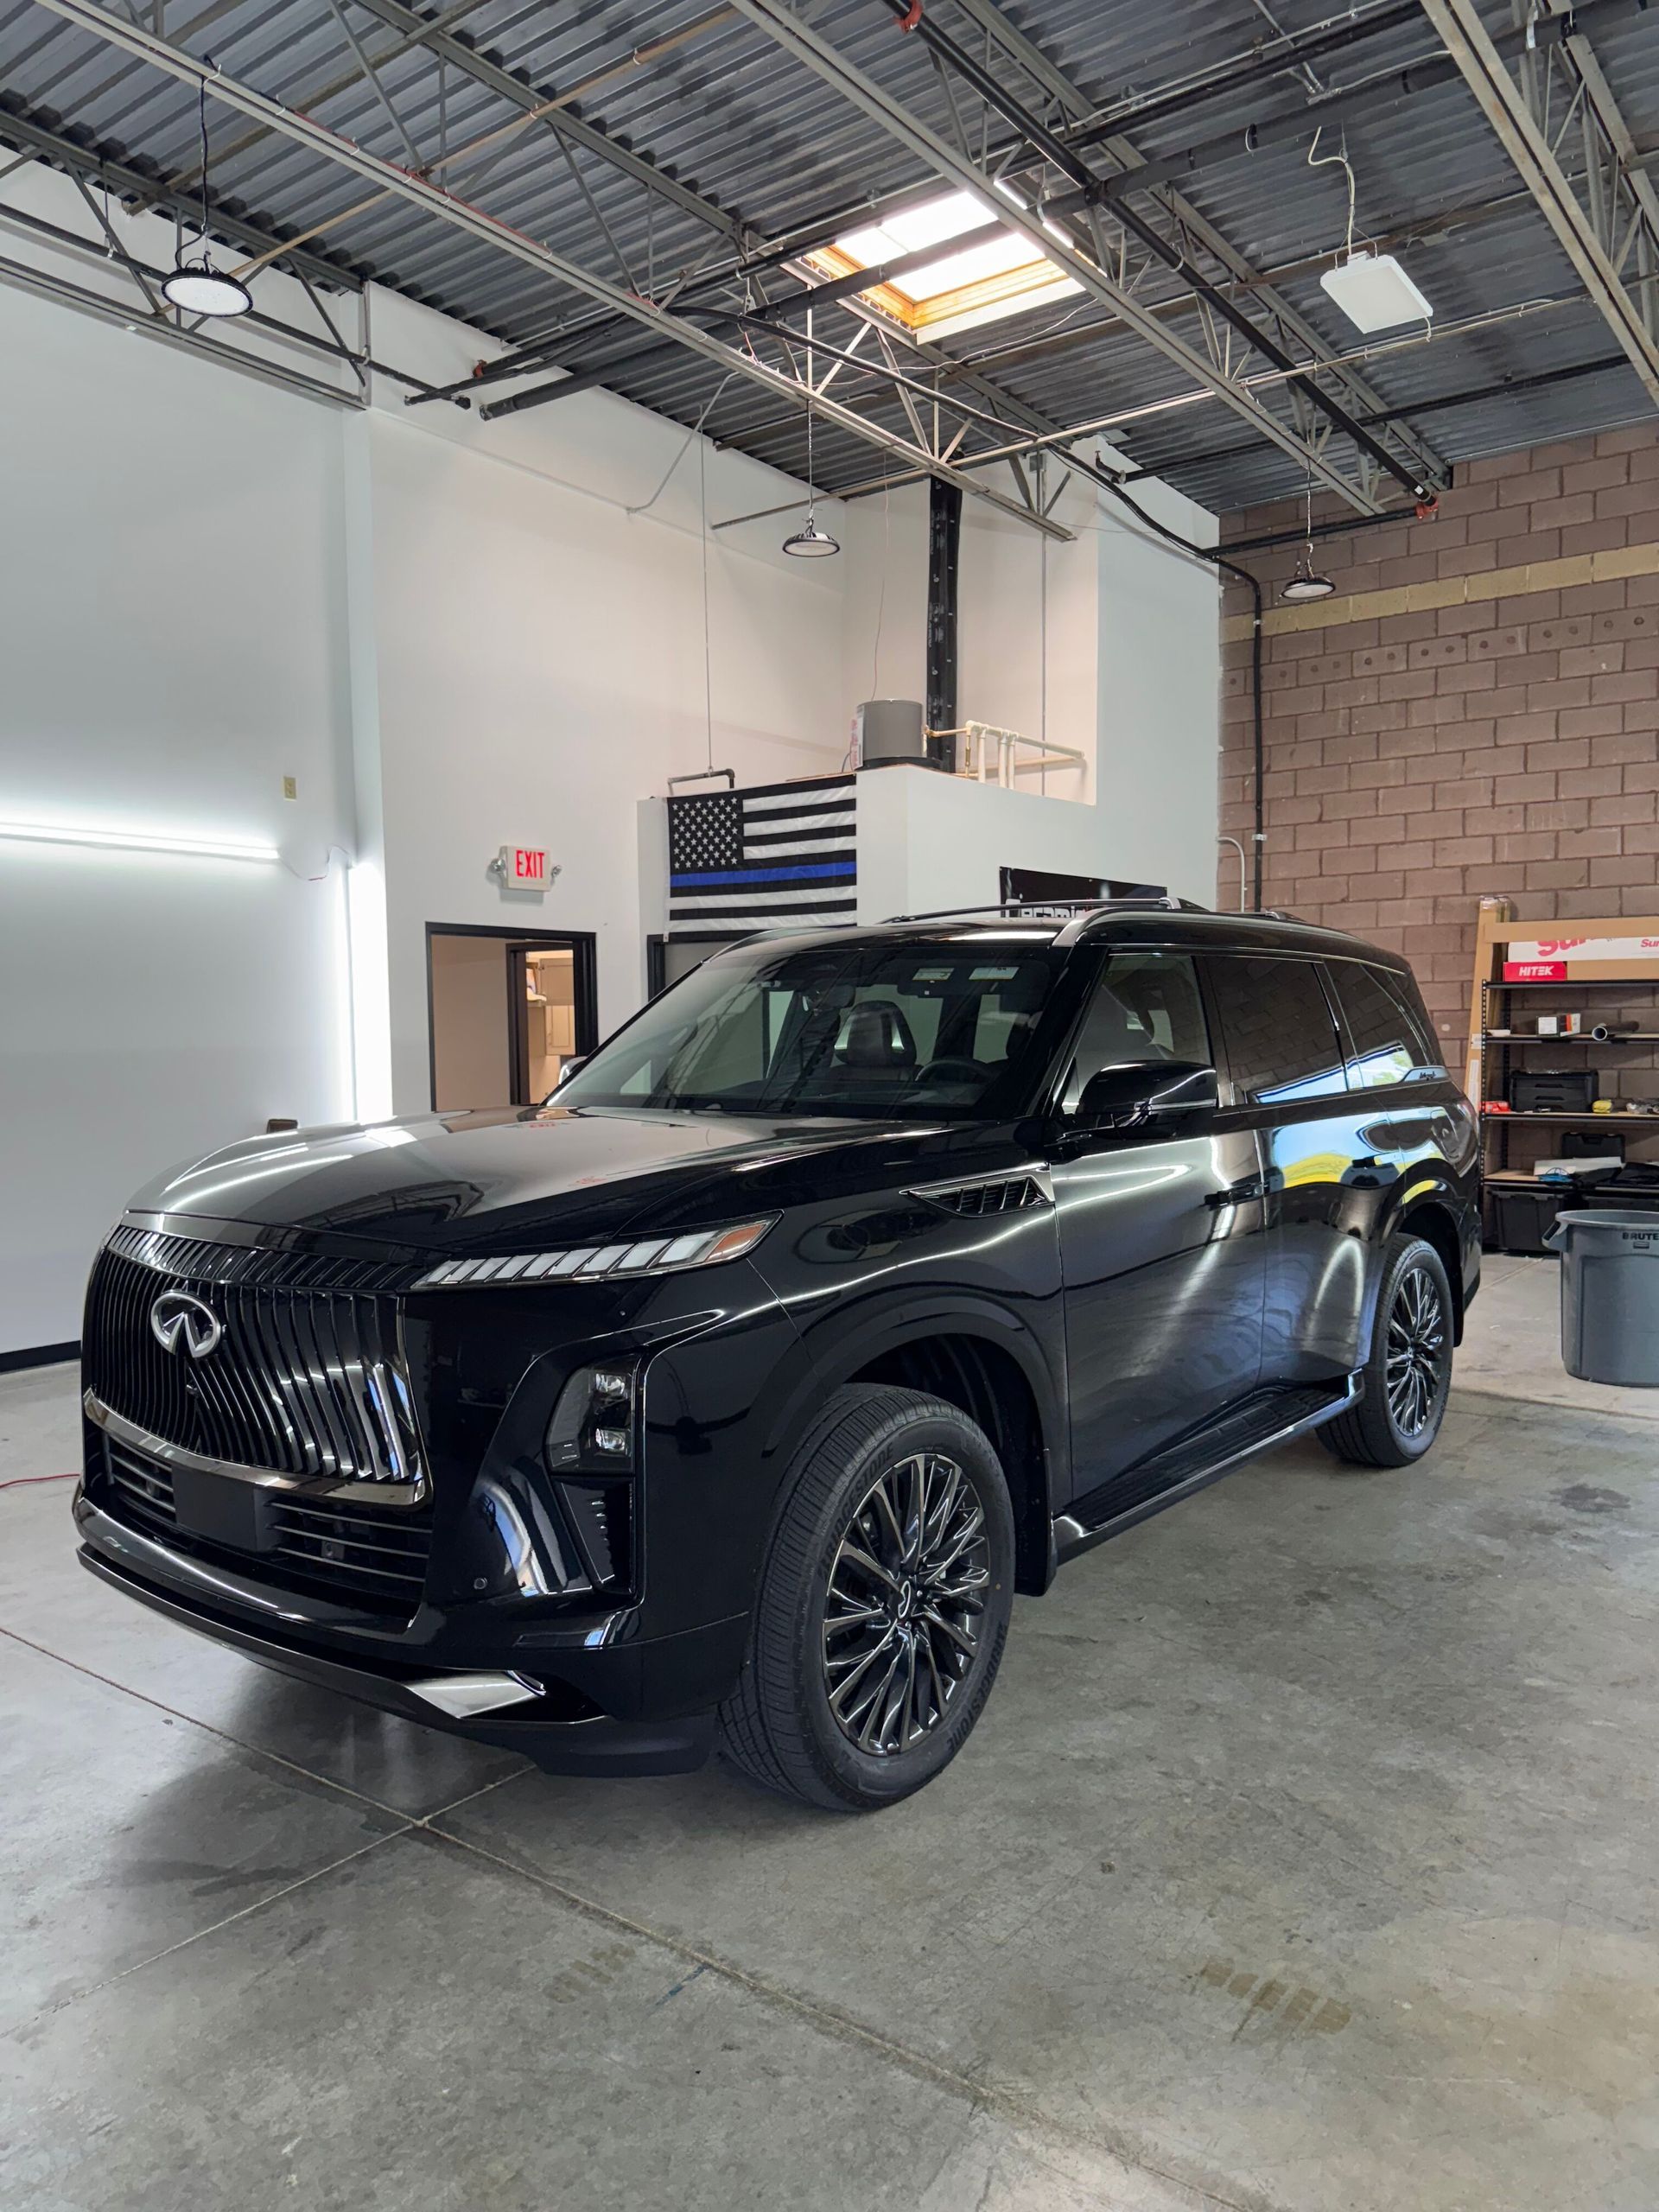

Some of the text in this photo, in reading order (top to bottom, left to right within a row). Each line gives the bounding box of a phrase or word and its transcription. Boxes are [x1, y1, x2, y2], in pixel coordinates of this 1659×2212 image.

[516, 849, 544, 879] EXIT
[1519, 965, 1554, 976] HITEK
[1622, 1231, 1659, 1241] BRUTE
